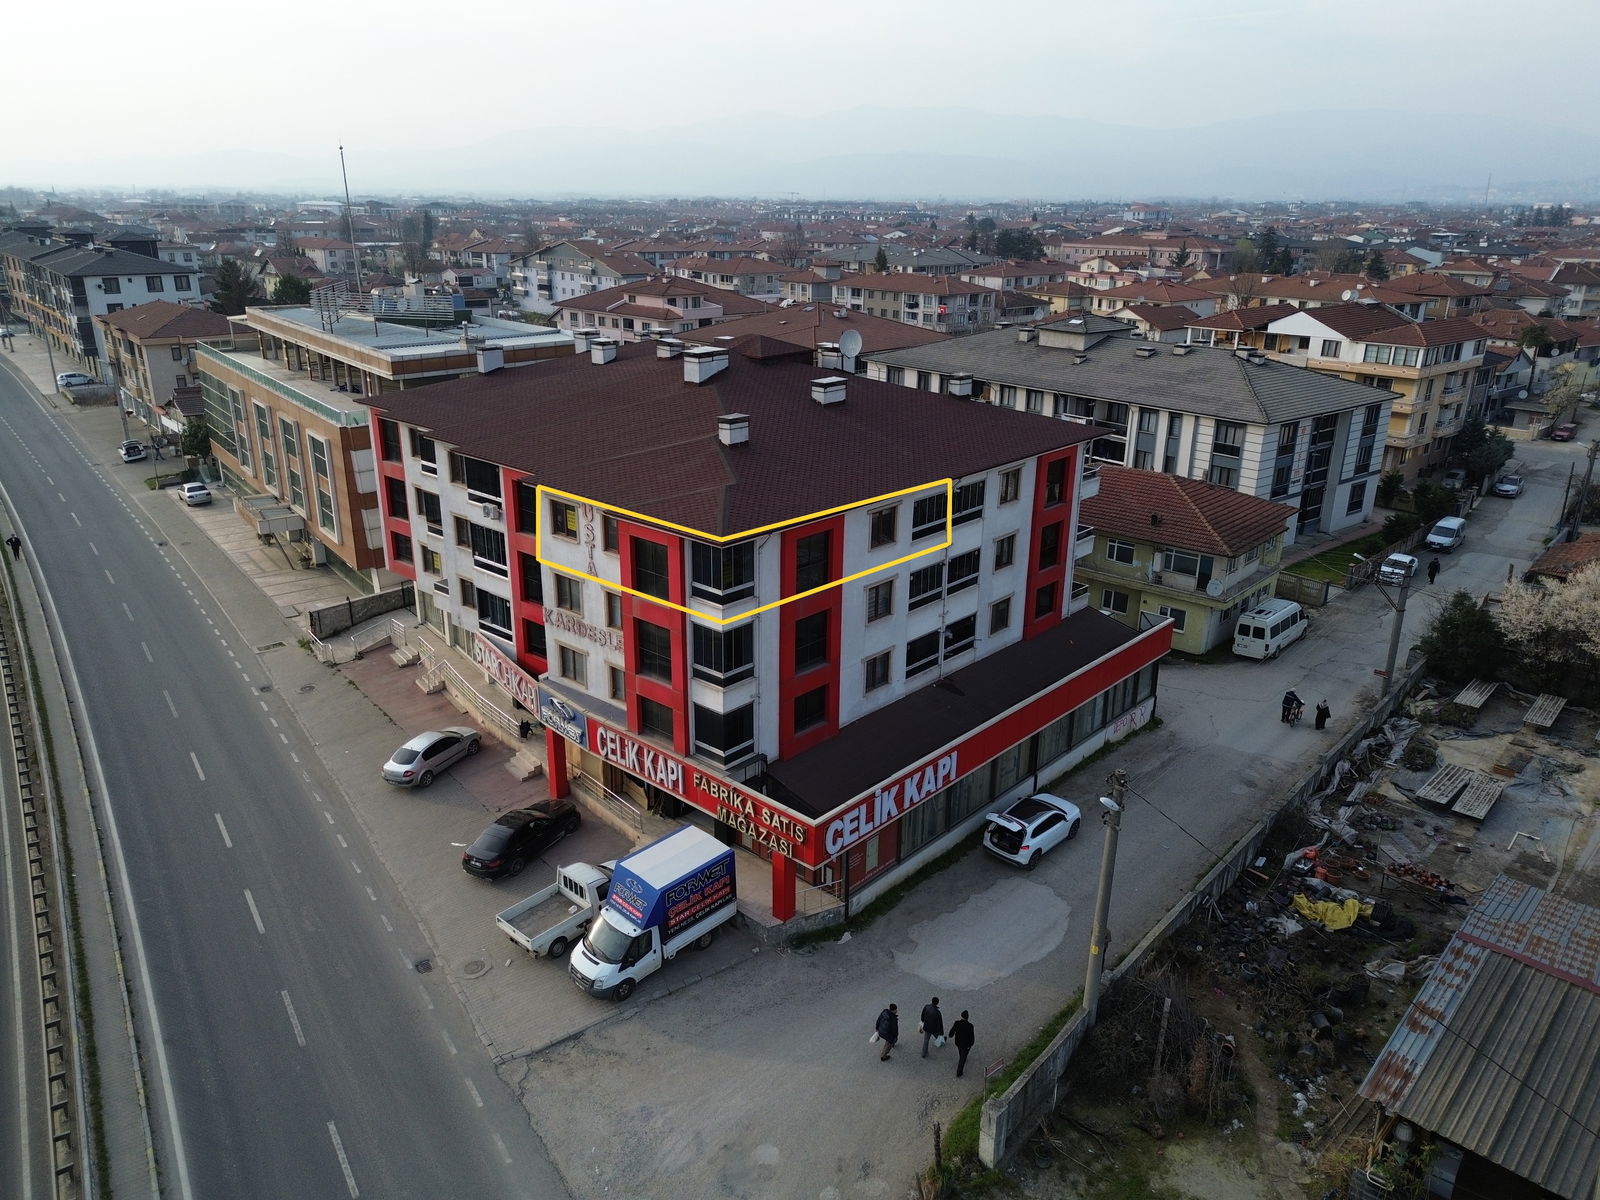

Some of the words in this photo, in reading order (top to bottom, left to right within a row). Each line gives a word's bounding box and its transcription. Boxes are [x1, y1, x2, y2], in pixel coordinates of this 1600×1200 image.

[581, 502, 599, 578] USTA
[643, 749, 684, 795] KAPI
[693, 773, 755, 818] FABRİKA
[825, 784, 899, 862] ÇELİK
[903, 750, 958, 809] KAPI
[717, 805, 793, 858] MAĞAZASI
[614, 882, 647, 911] FORMET
[666, 857, 730, 907] FORMET
[668, 891, 702, 918] ÇELİK
[670, 911, 690, 924] STAR
